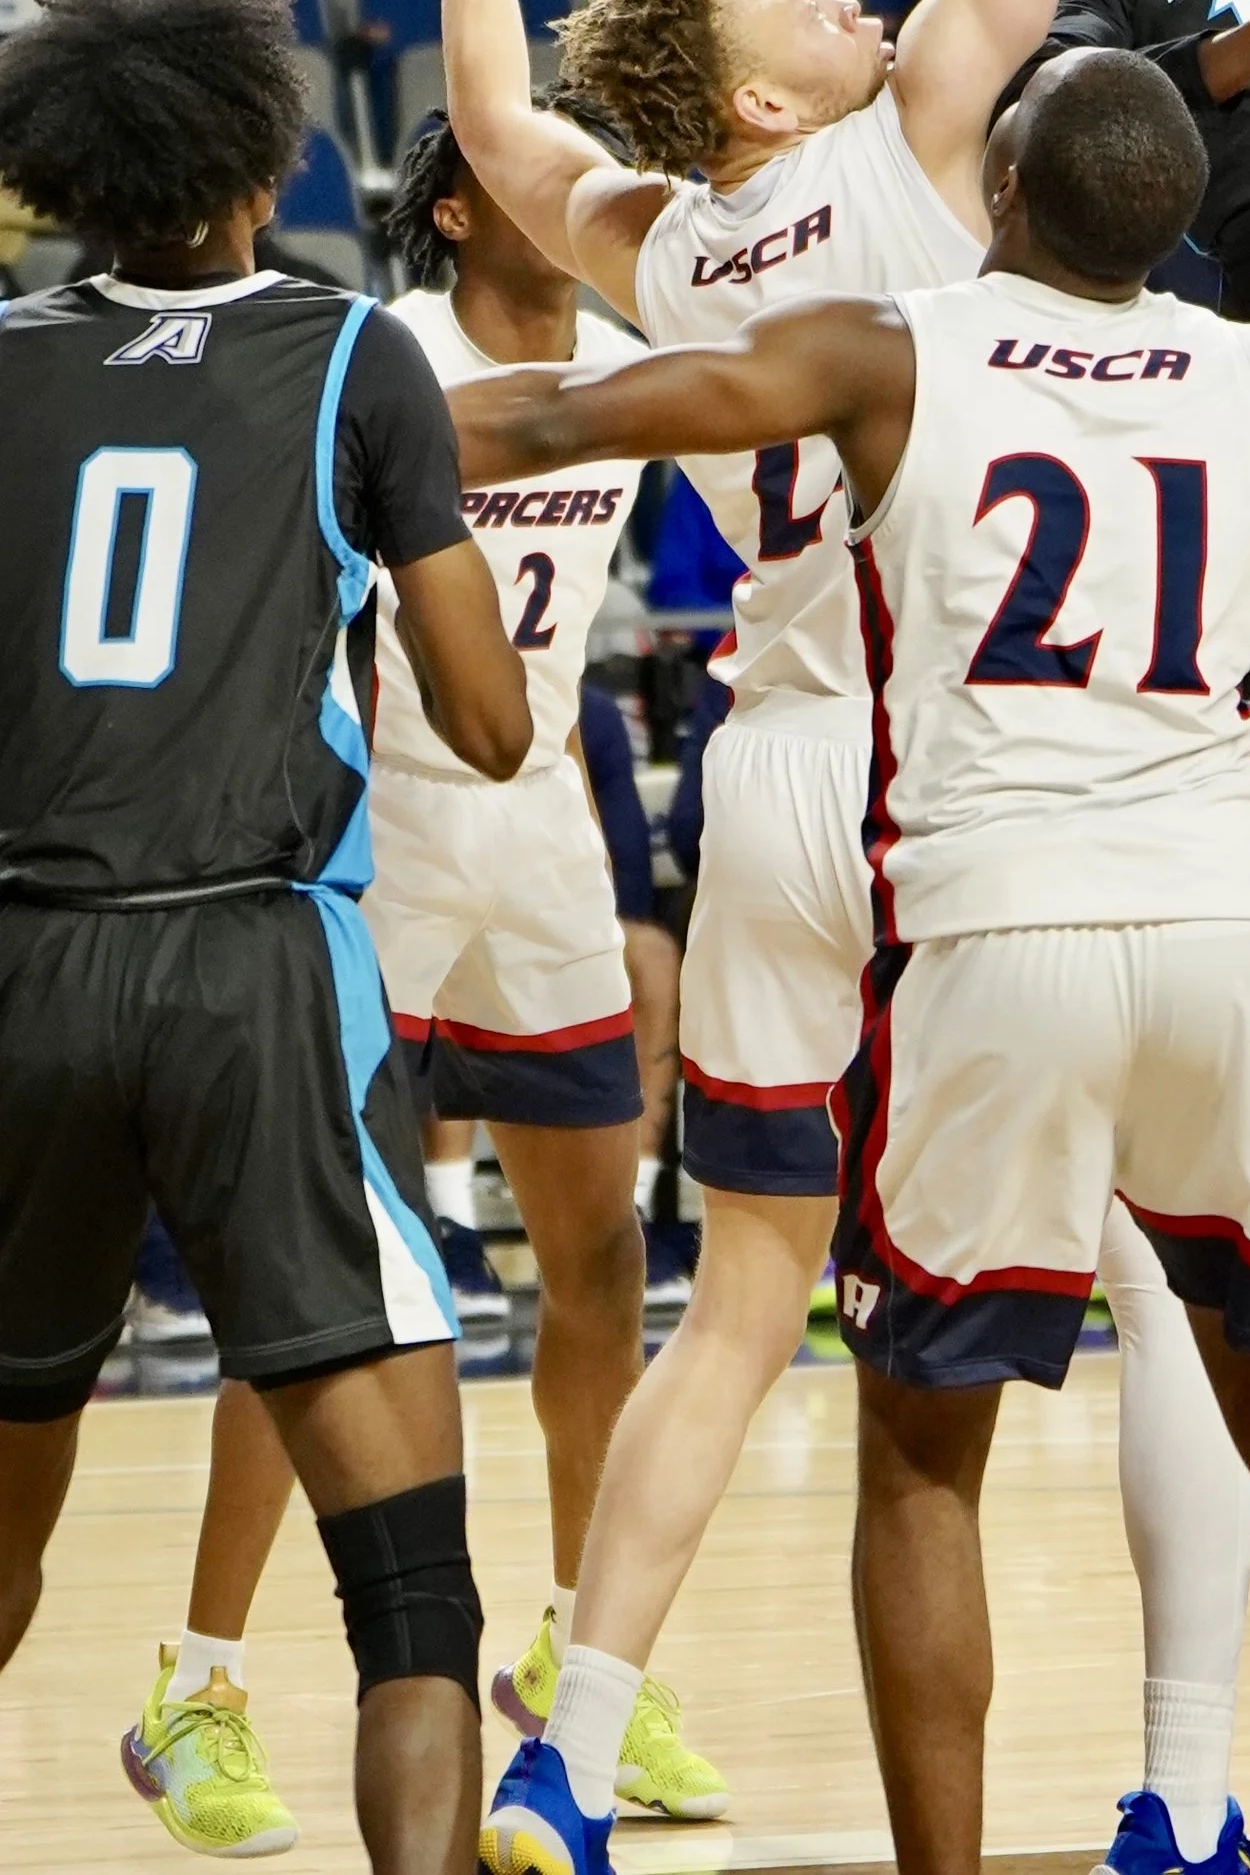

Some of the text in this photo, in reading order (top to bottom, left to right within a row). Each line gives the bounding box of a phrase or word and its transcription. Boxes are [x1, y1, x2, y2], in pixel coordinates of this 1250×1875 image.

[690, 204, 832, 287] USCA
[103, 311, 212, 366] A
[987, 339, 1192, 382] USCA
[460, 487, 625, 529] PACERS
[58, 446, 199, 689] 0
[513, 551, 560, 653] 2
[963, 451, 1211, 696] 21
